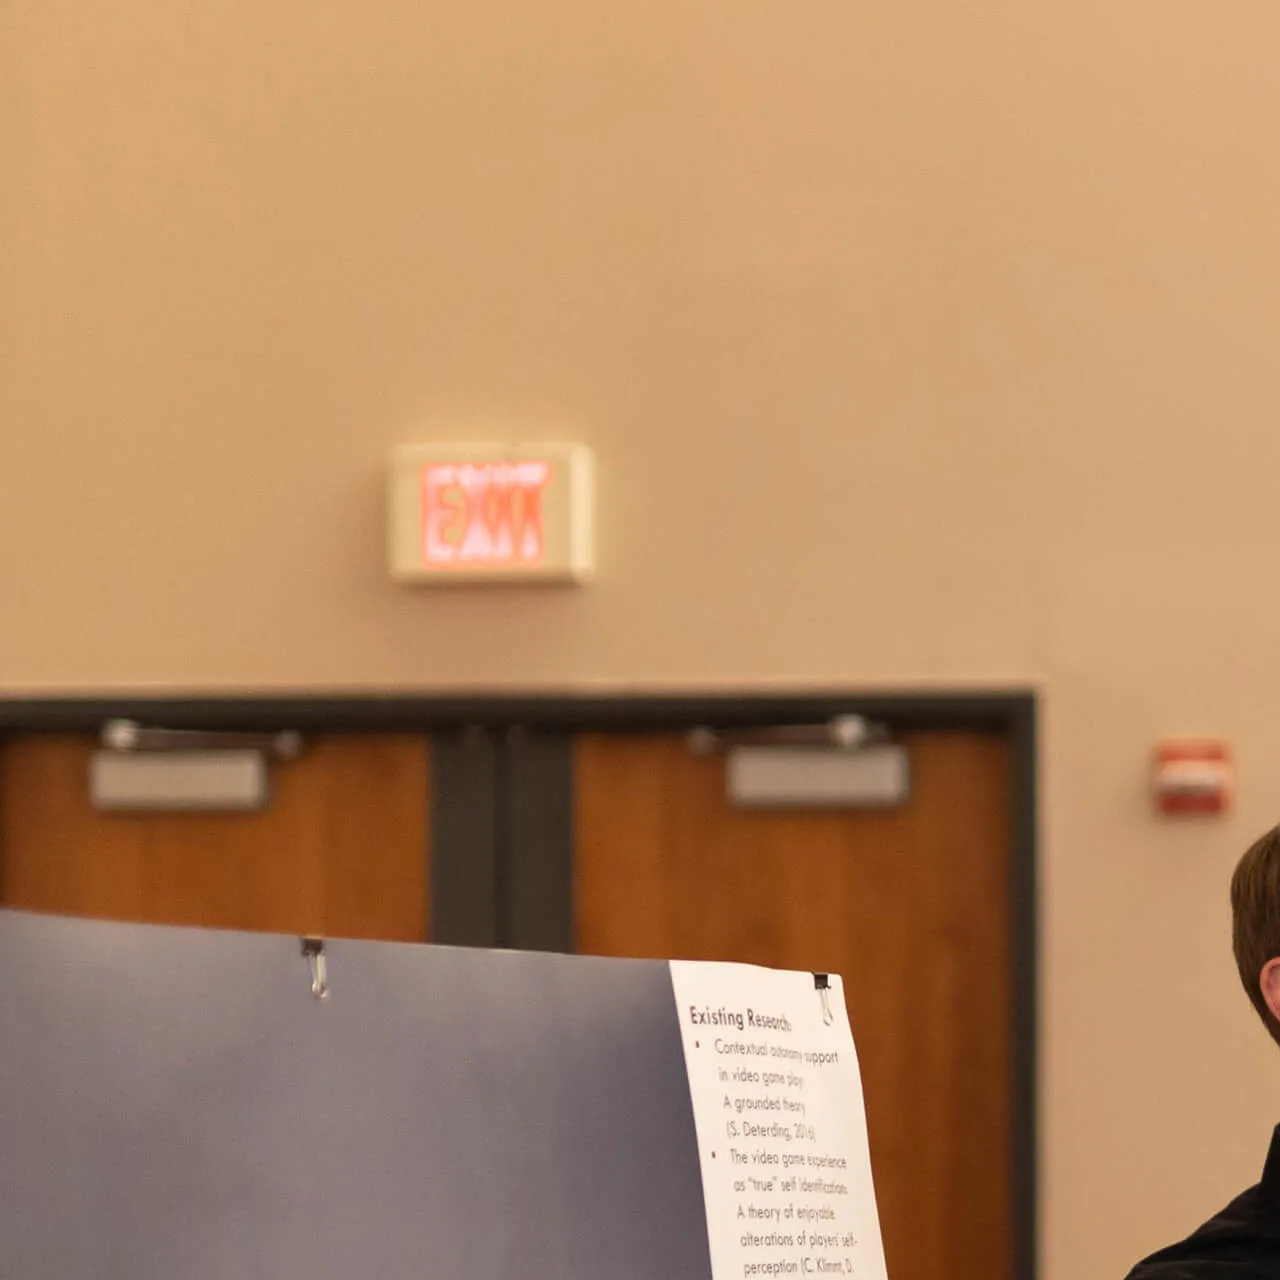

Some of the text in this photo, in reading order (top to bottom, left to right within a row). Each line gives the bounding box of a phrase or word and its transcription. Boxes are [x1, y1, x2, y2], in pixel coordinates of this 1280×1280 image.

[420, 460, 553, 569] EXIT
[690, 1006, 744, 1030] Existing
[714, 1039, 838, 1066] Contextual support
[733, 1068, 785, 1086] video game
[724, 1097, 781, 1112] A grounded
[730, 1149, 805, 1167] The video game
[737, 1204, 793, 1222] A theory of
[740, 1231, 806, 1247] alterations of
[744, 1260, 797, 1278] perception
